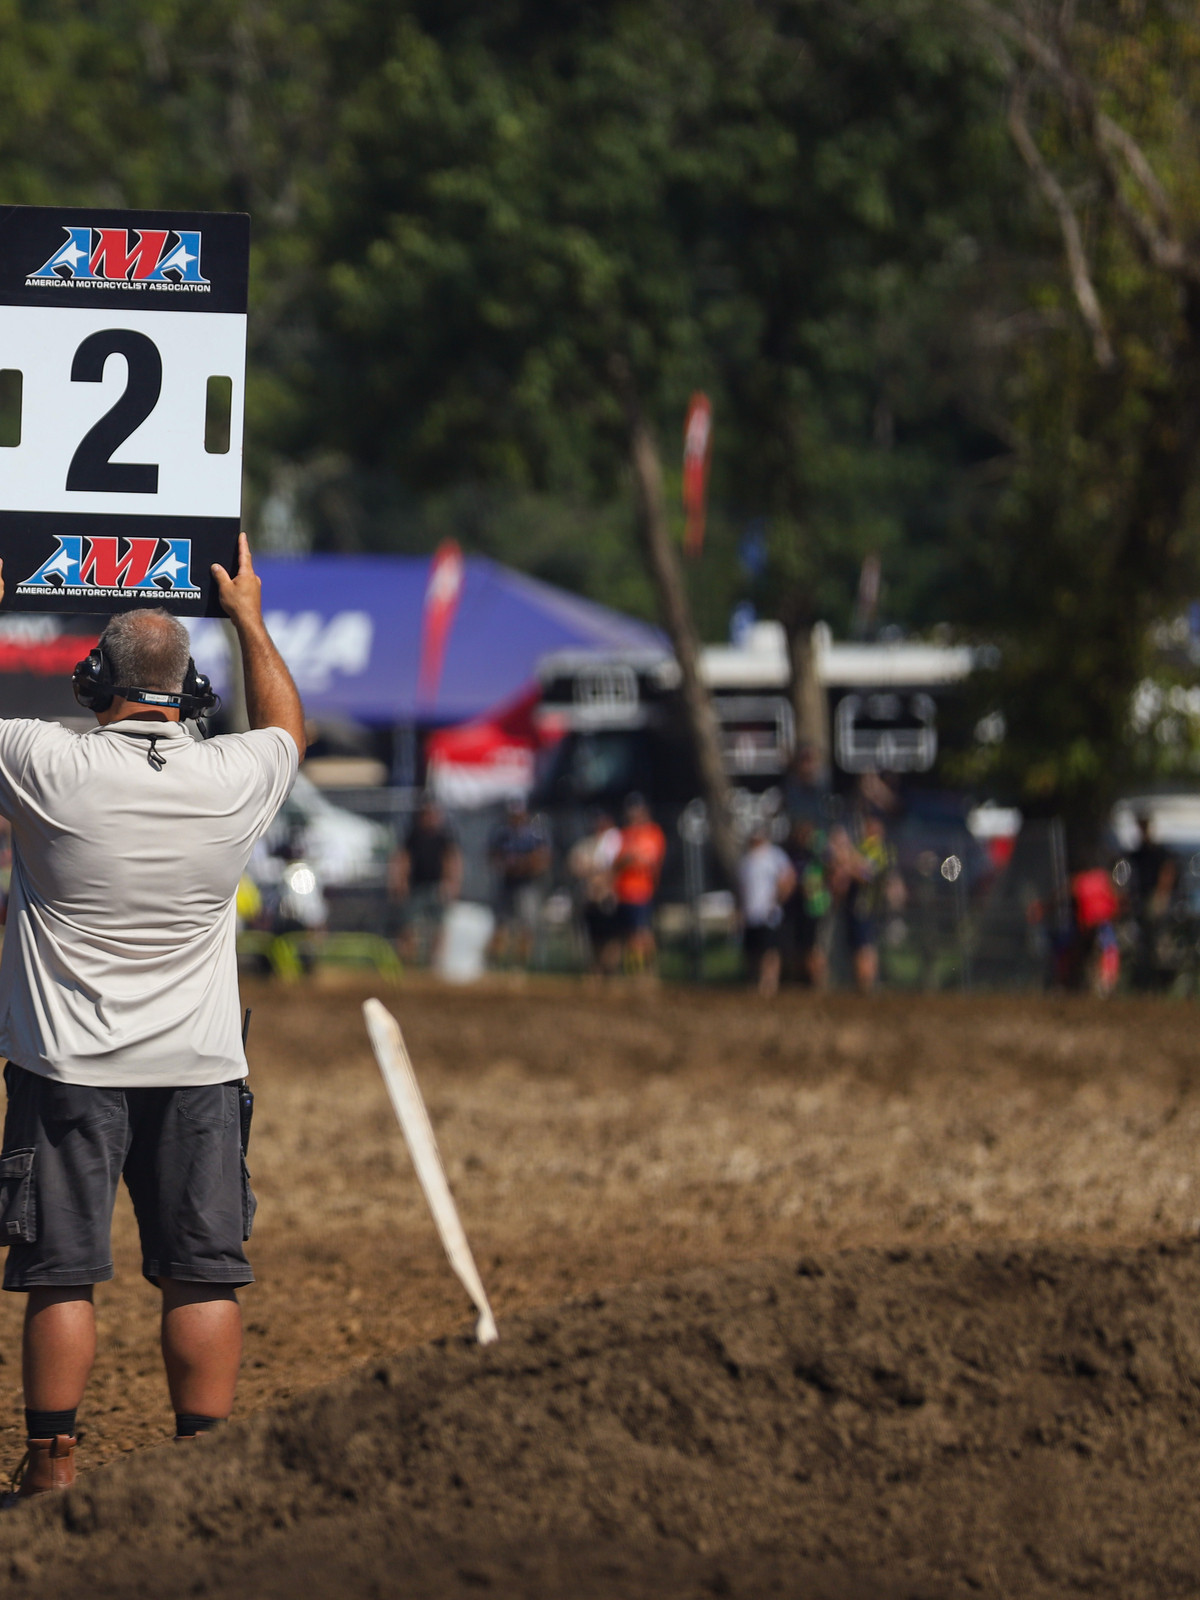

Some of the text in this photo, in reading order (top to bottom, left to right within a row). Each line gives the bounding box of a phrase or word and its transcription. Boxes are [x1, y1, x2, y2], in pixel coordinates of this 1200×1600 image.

[26, 227, 211, 283] AMA
[25, 279, 211, 292] AMERICAN MOTORCYCLIST ASSOCIATION
[66, 328, 163, 494] 2
[16, 535, 201, 590] AMA
[15, 587, 201, 599] AMERICAN MOTORCYCLIST ASSOCIATION
